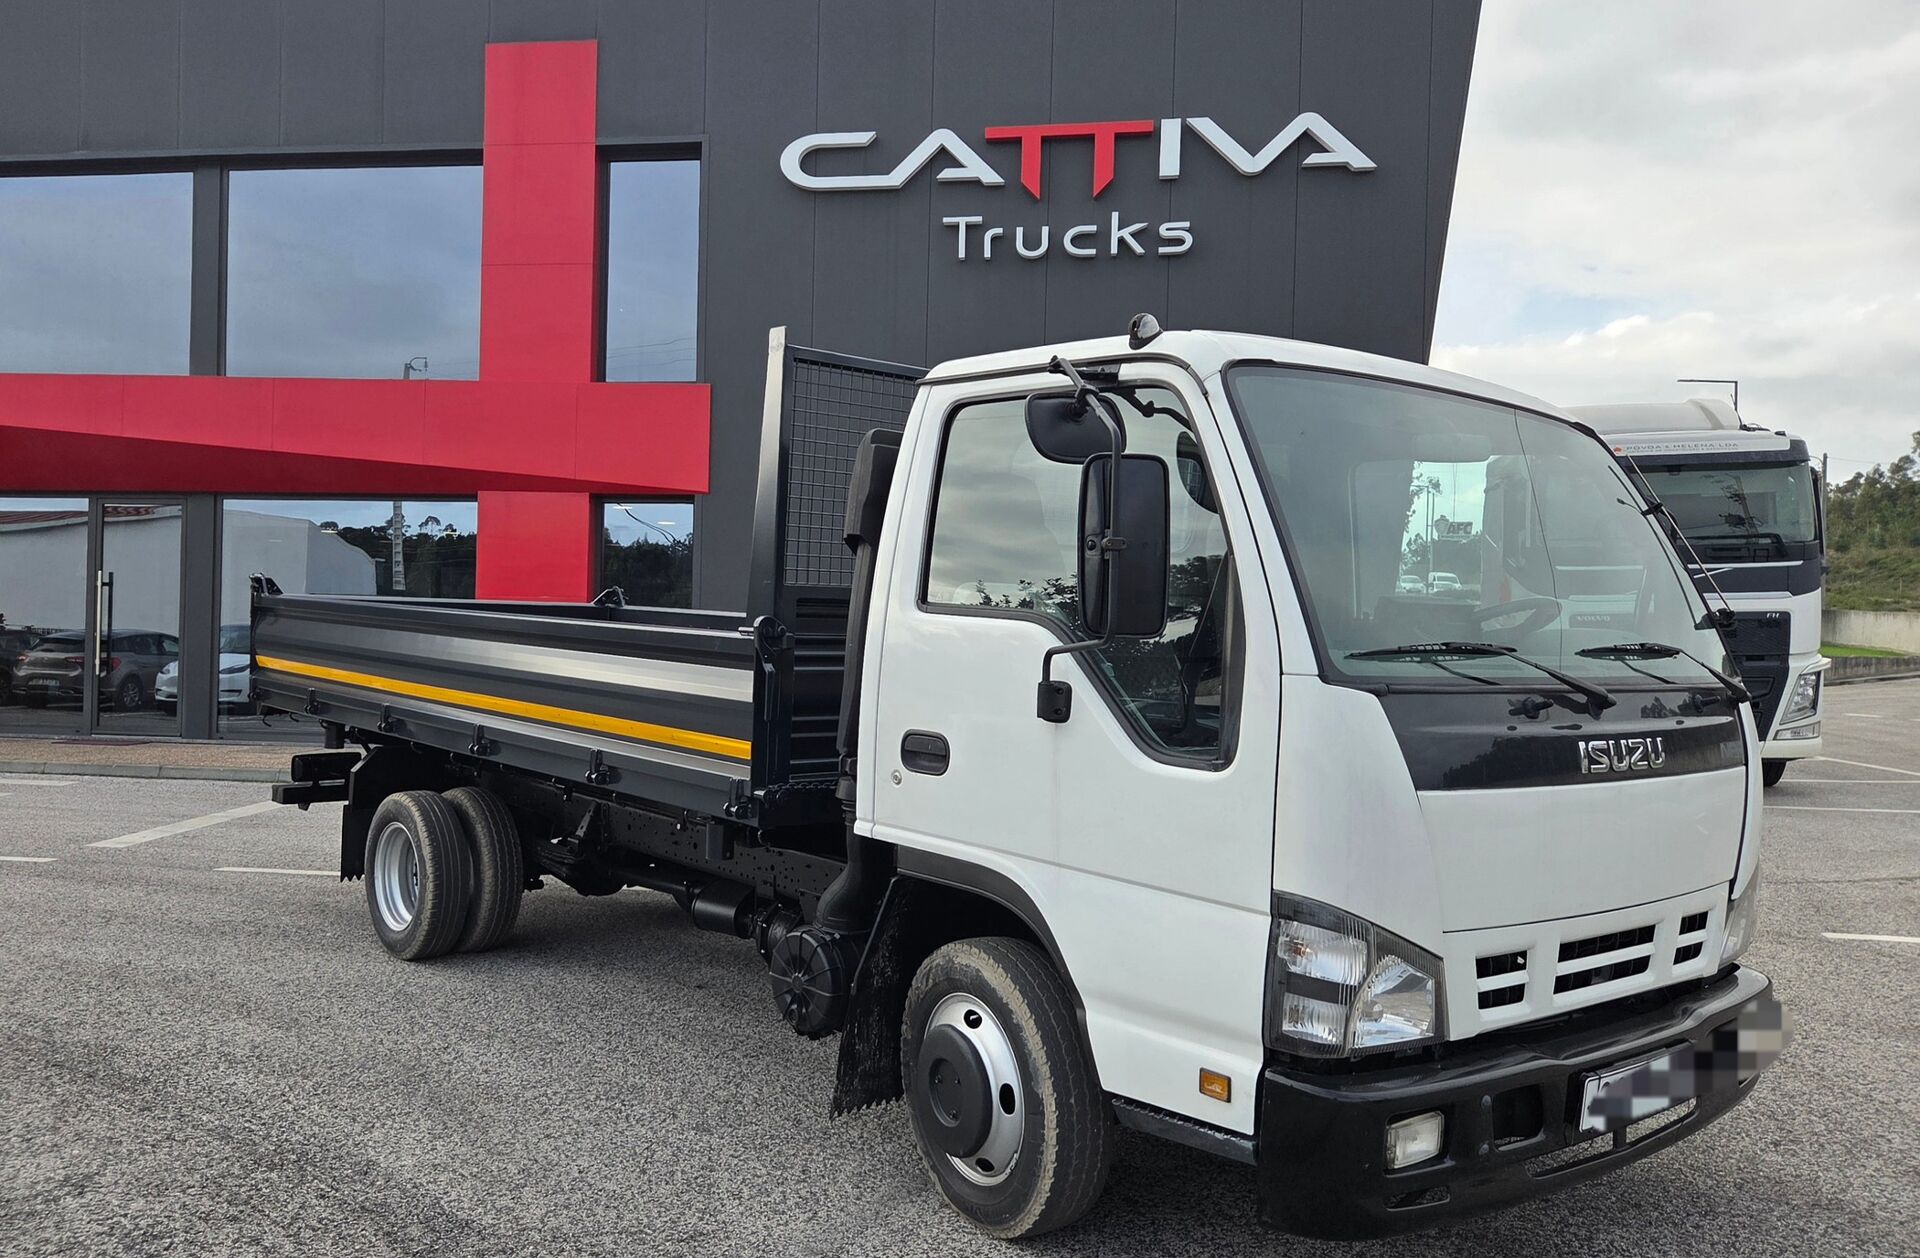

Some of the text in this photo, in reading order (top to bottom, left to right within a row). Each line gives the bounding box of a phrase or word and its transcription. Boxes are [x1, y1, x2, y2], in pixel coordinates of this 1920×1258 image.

[779, 112, 1377, 199] CATTIVA
[943, 211, 1193, 260] Trucks
[1578, 737, 1666, 774] ISUZU
